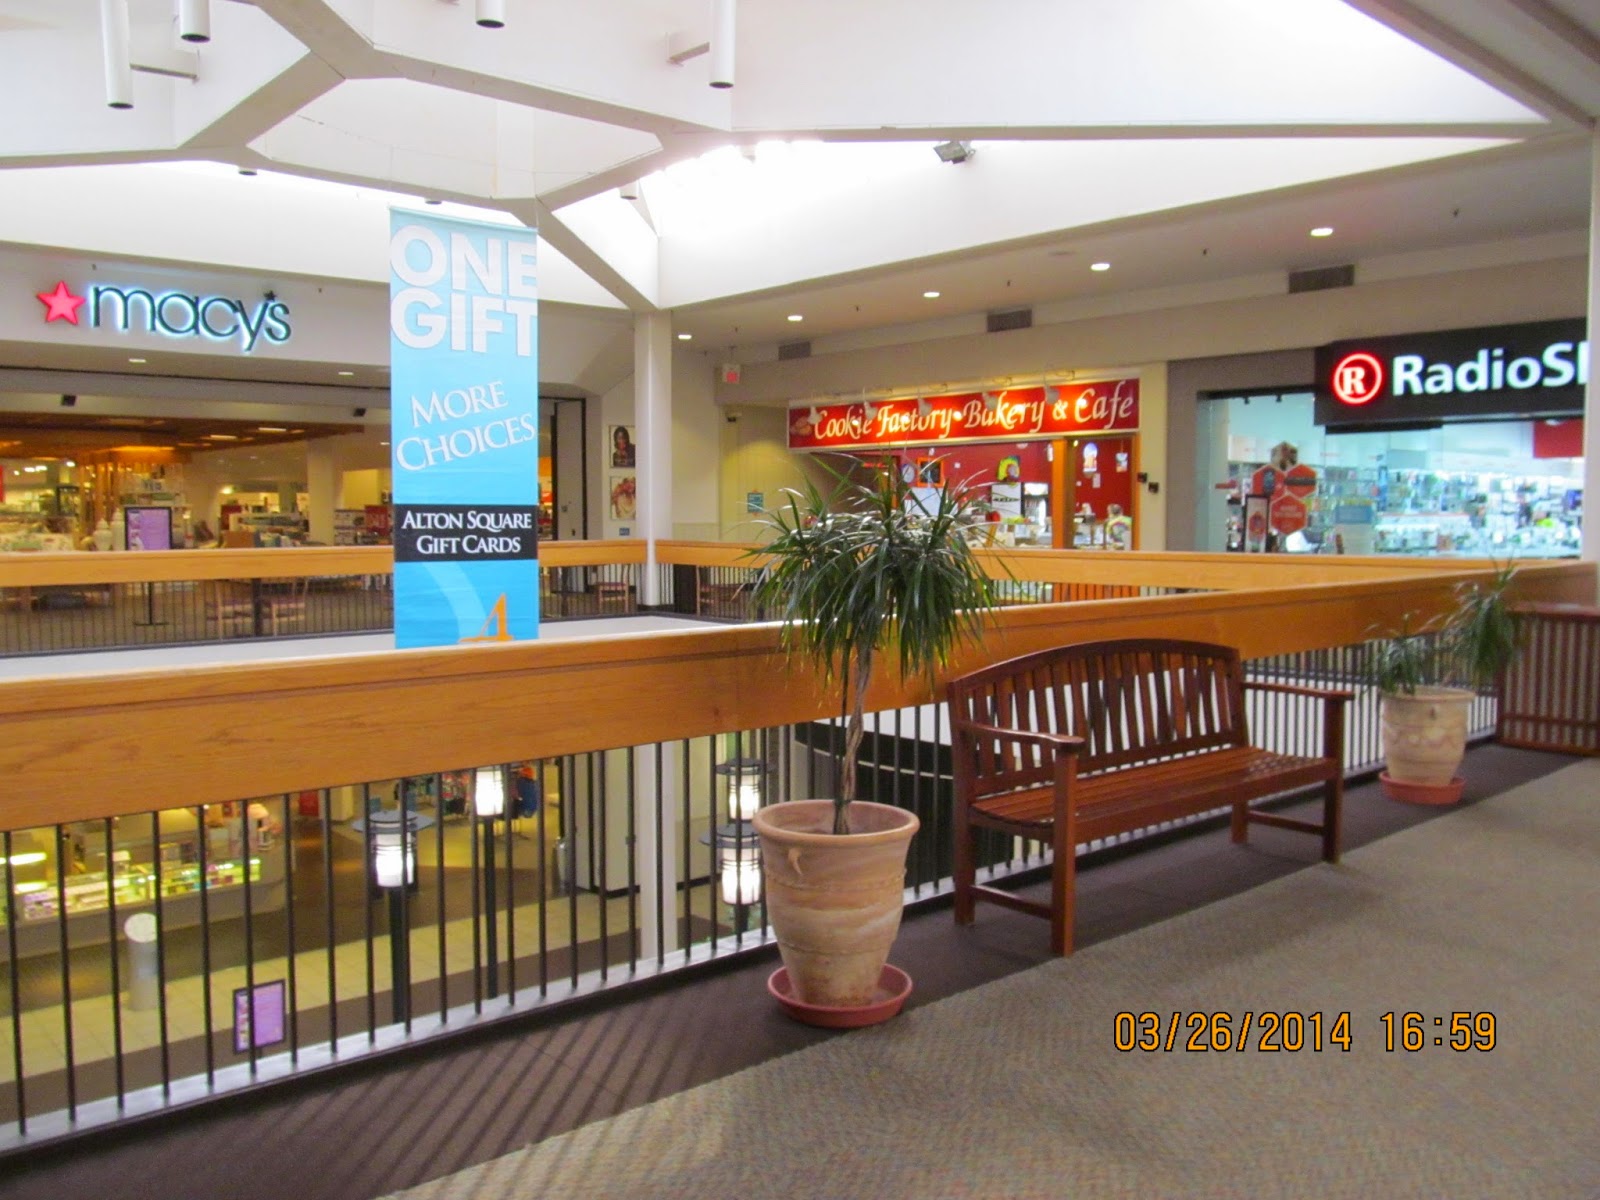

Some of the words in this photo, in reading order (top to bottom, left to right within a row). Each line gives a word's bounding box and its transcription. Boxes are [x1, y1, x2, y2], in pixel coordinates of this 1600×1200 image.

[390, 224, 537, 298] ONE
[92, 286, 291, 351] macy's
[390, 287, 538, 357] GIFT
[411, 381, 508, 428] MORE
[814, 405, 873, 440] Cookie
[876, 404, 953, 439] Factory
[1052, 399, 1068, 421] &
[396, 413, 537, 471] CHOICES
[401, 510, 463, 530] ALTON
[467, 510, 532, 533] SQUARE
[416, 535, 460, 555] GIFT
[462, 535, 521, 553] CARDS
